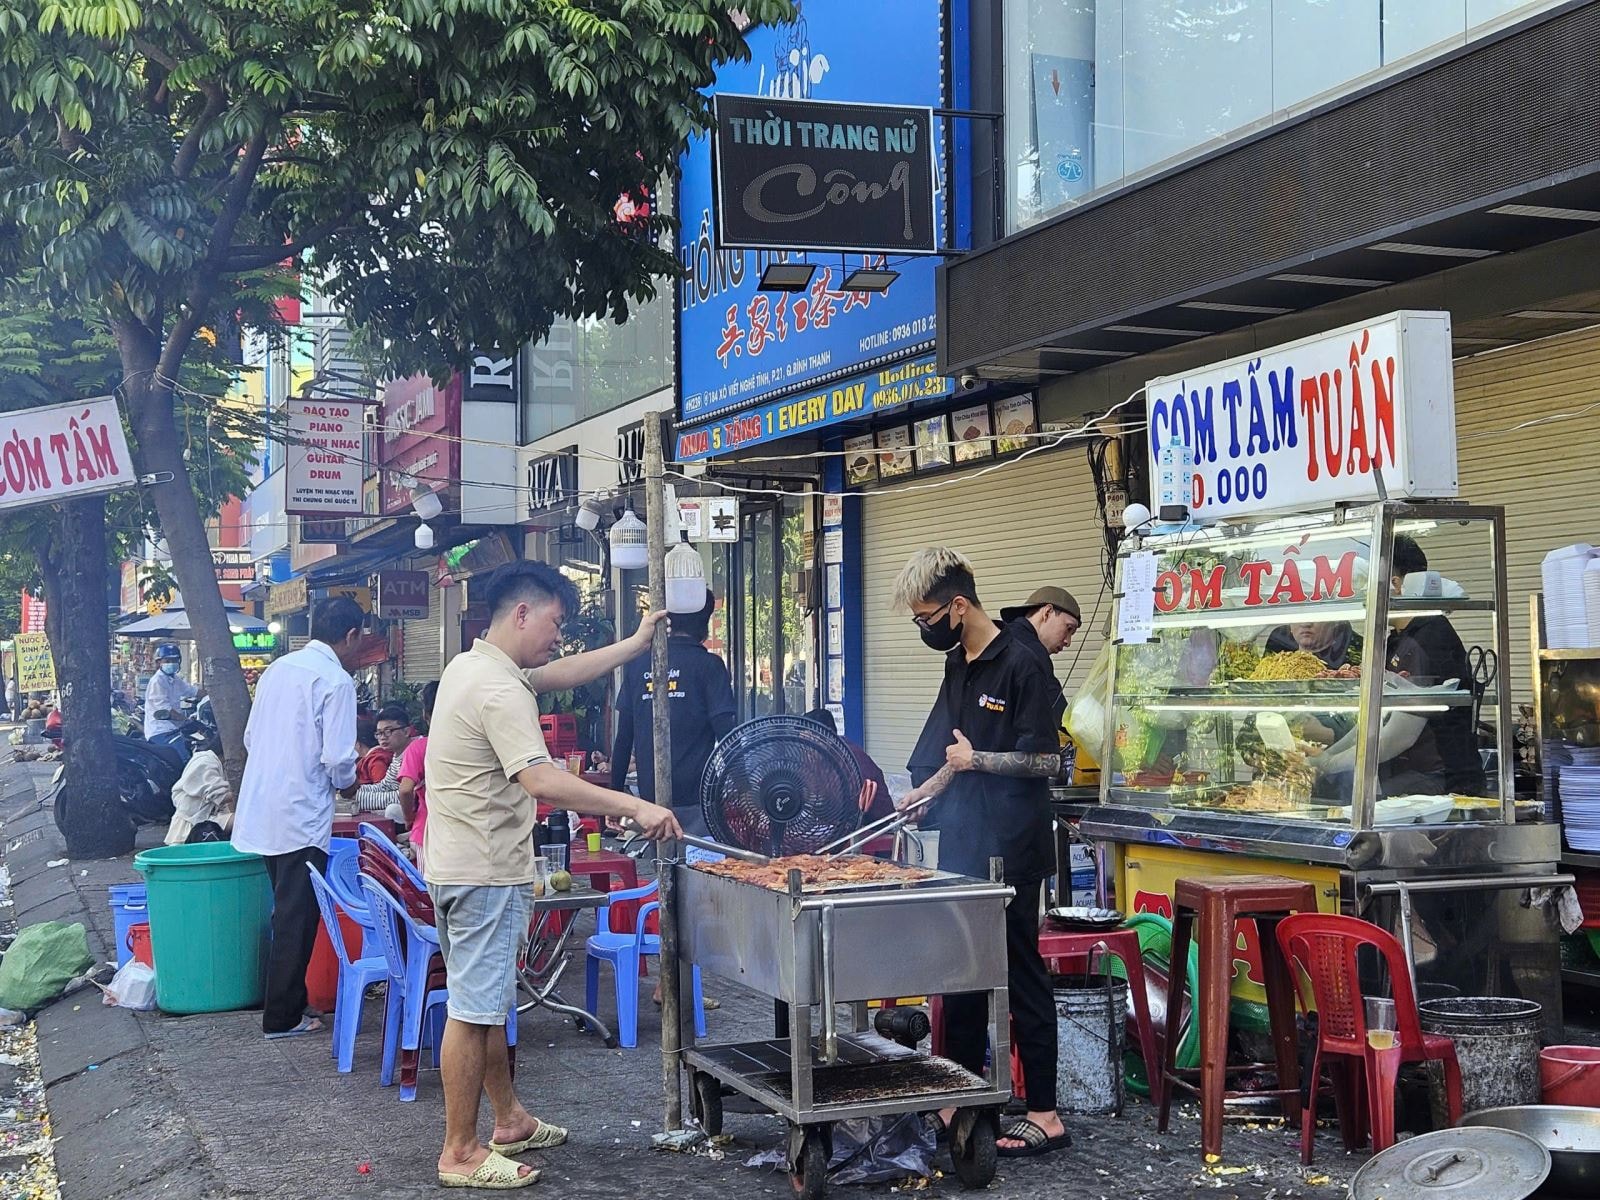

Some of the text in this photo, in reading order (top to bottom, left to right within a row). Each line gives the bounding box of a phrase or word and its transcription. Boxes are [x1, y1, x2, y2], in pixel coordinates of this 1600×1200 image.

[728, 111, 918, 153] THỜI TRANG NỮ
[892, 323, 911, 342] 0936
[912, 317, 927, 334] 018
[808, 350, 832, 370] THẠNH
[872, 376, 948, 410] 0936.018.231
[329, 408, 350, 418] TẠO
[1151, 329, 1396, 482] CƠM TẤM TUẤN
[309, 422, 343, 432] PIANO
[679, 382, 868, 459] MUA 5 TẶNG 1 EVERY DAY
[50, 408, 119, 485] TẤM
[331, 440, 360, 451] NHẠC
[306, 454, 345, 464] GUITAR
[309, 470, 342, 480] DRUM
[527, 456, 565, 511] RUZA
[1240, 533, 1358, 606] TẤM
[383, 580, 426, 596] ATM
[403, 609, 421, 617] MSB
